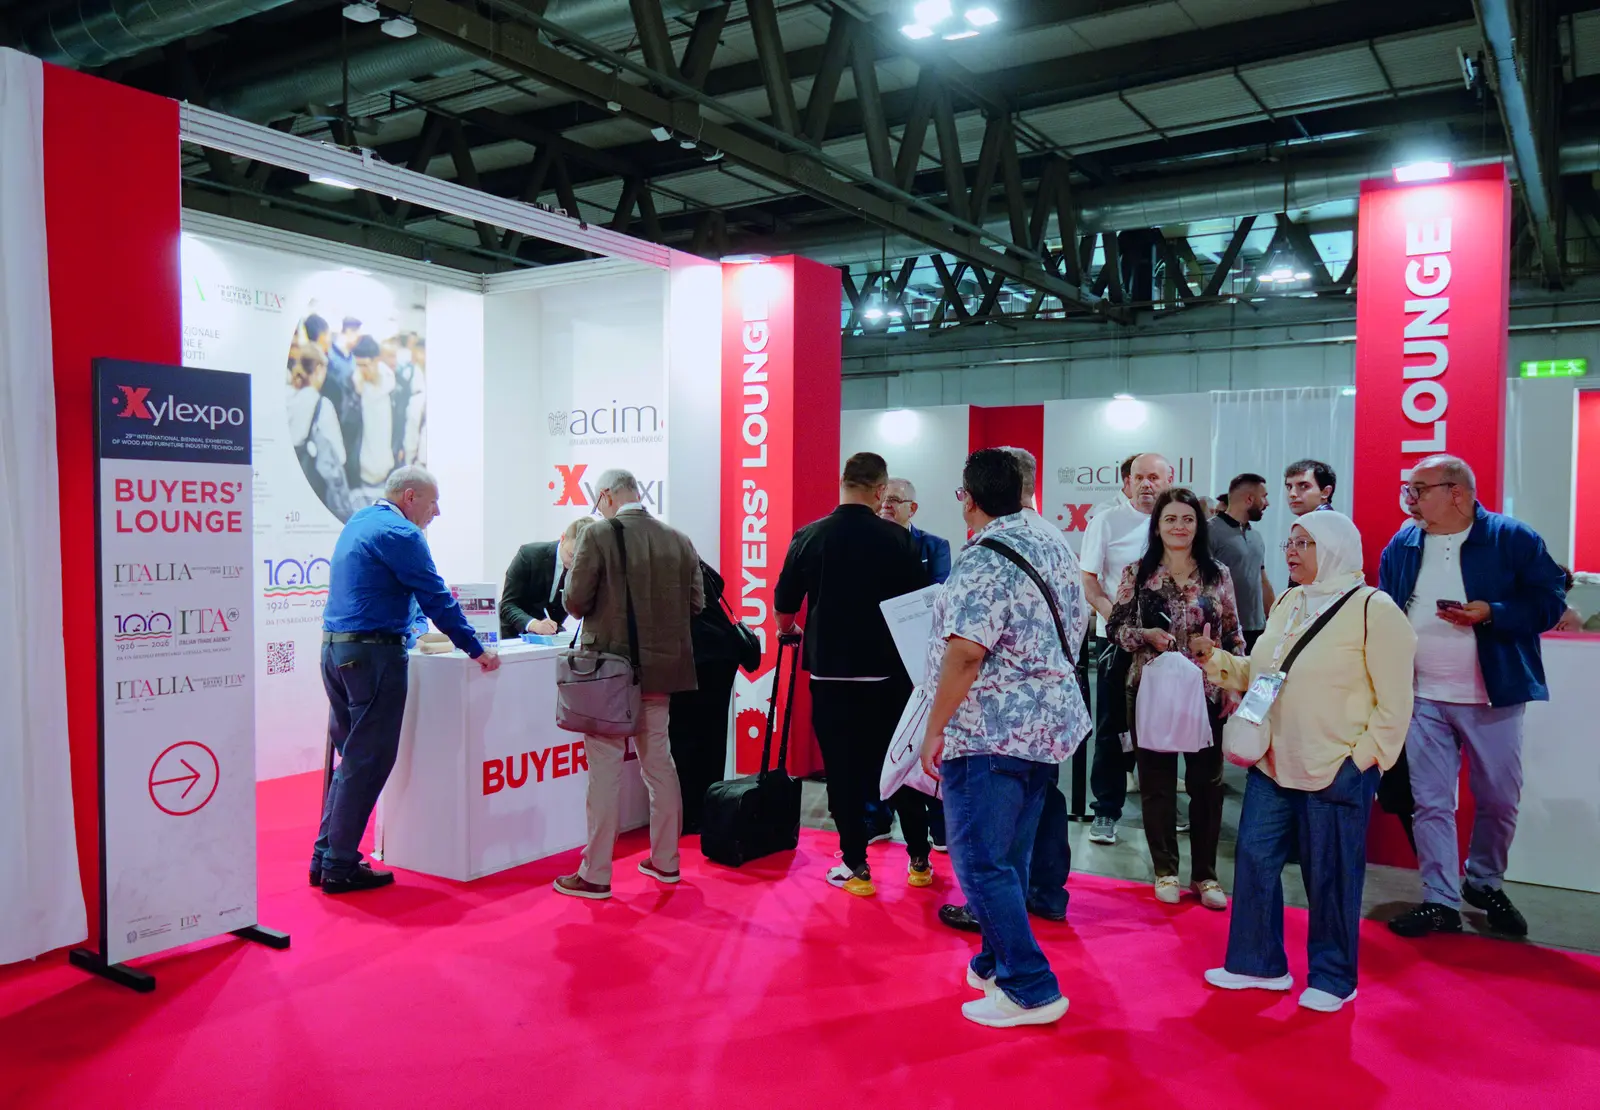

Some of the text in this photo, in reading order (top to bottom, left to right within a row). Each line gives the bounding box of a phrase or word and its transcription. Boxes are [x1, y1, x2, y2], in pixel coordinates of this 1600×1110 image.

[183, 325, 220, 339] ZIONALE
[1401, 217, 1451, 453] LOUNGE
[116, 384, 245, 430] Xylexpo
[569, 399, 663, 436] acim
[136, 434, 180, 442] INTERNATIONAL
[1077, 457, 1193, 485] acill
[116, 510, 243, 533] LOUNGE
[113, 563, 194, 583] ITALIA
[267, 598, 326, 613] 1926 202
[178, 608, 232, 635] ITA
[117, 640, 170, 652] 1926 2026
[115, 676, 196, 700] ITALIA
[482, 740, 589, 796] BUYER
